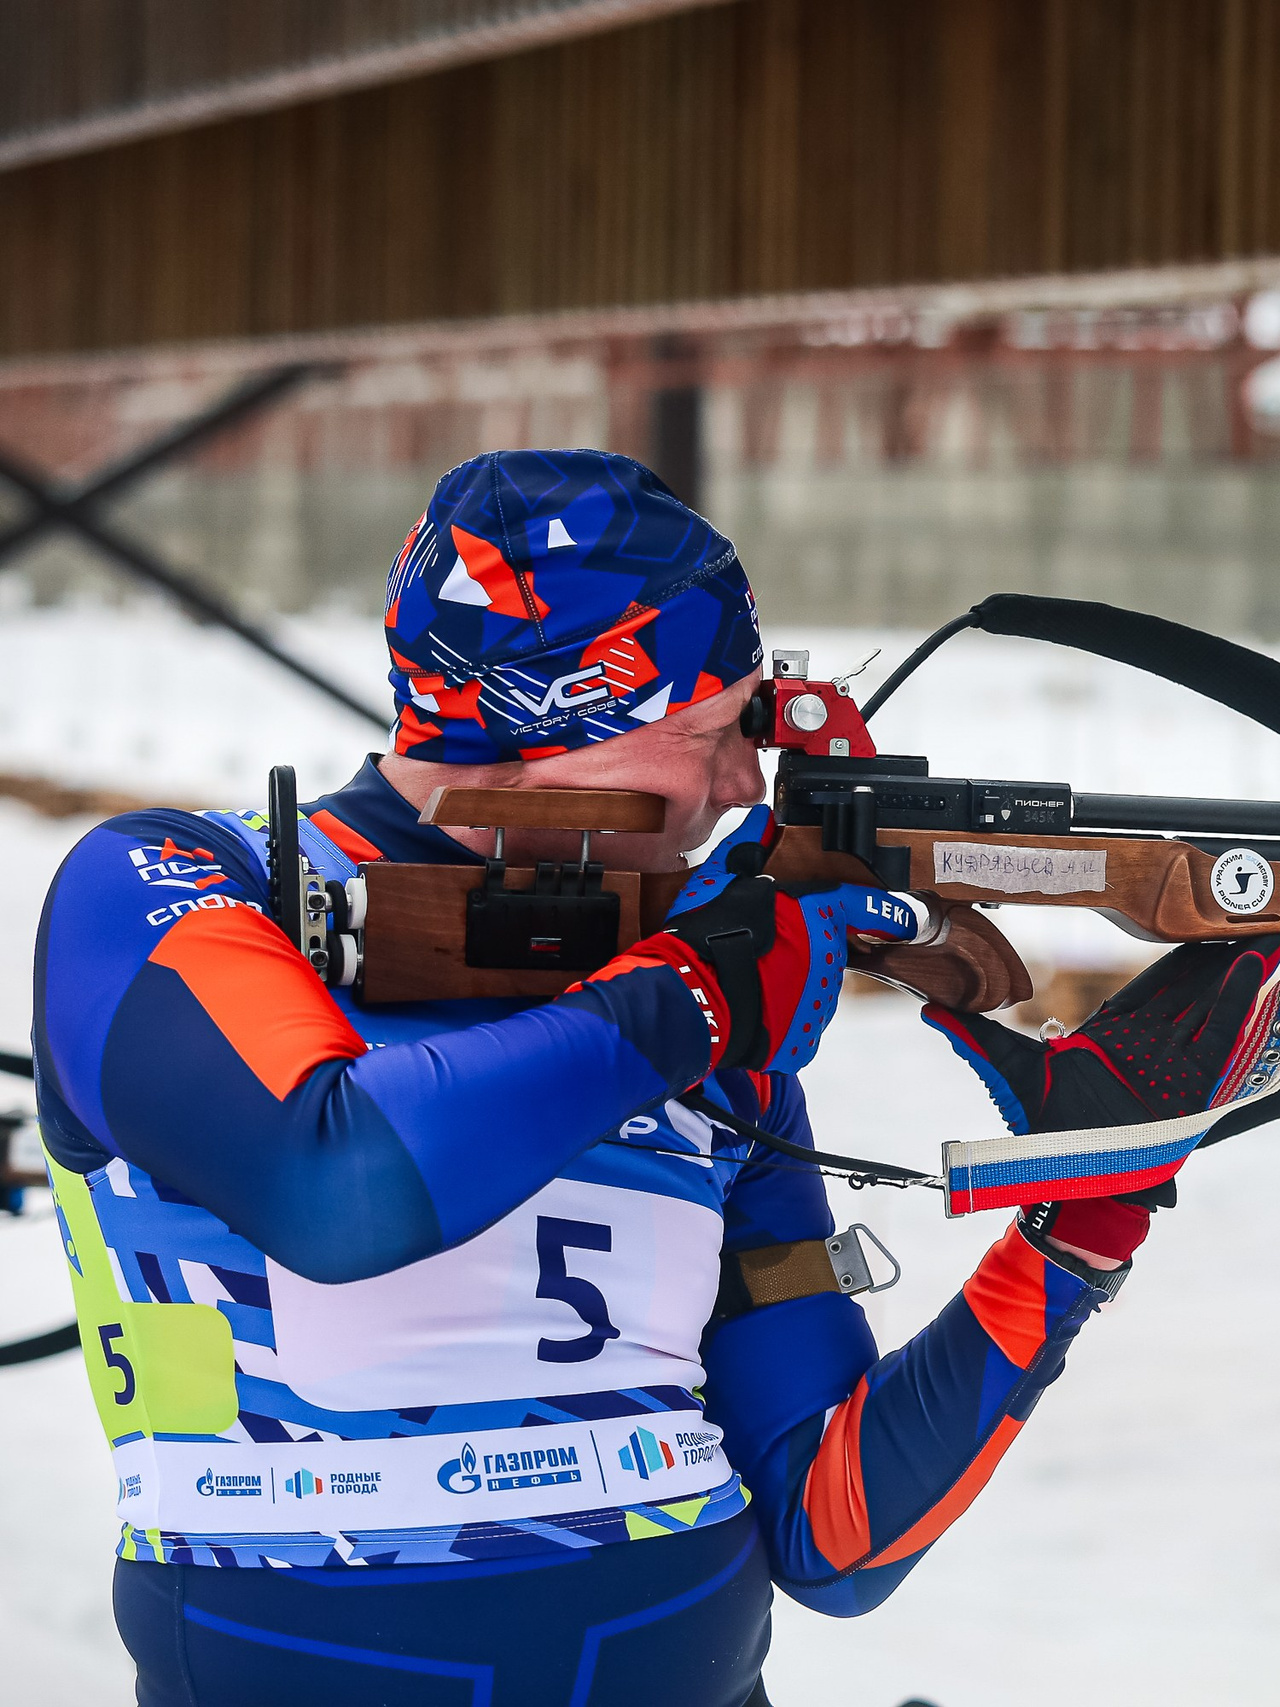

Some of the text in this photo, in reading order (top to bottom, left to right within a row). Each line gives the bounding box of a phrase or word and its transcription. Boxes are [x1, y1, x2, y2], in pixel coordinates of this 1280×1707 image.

[1014, 800, 1064, 808] ПИОНЕР
[1216, 854, 1243, 887] УРАЛХИМ
[1218, 889, 1266, 911] PIONER CUP
[866, 895, 909, 928] LEKI
[535, 1215, 621, 1364] 5
[97, 1323, 136, 1406] 5
[483, 1446, 579, 1475] ГАЗПРОМ
[215, 1475, 262, 1487] ГАЗПРОМ
[330, 1472, 382, 1484] РОДНЫЕ
[331, 1483, 379, 1495] ГОРОДА
[491, 1471, 578, 1490] НЕФТЬ
